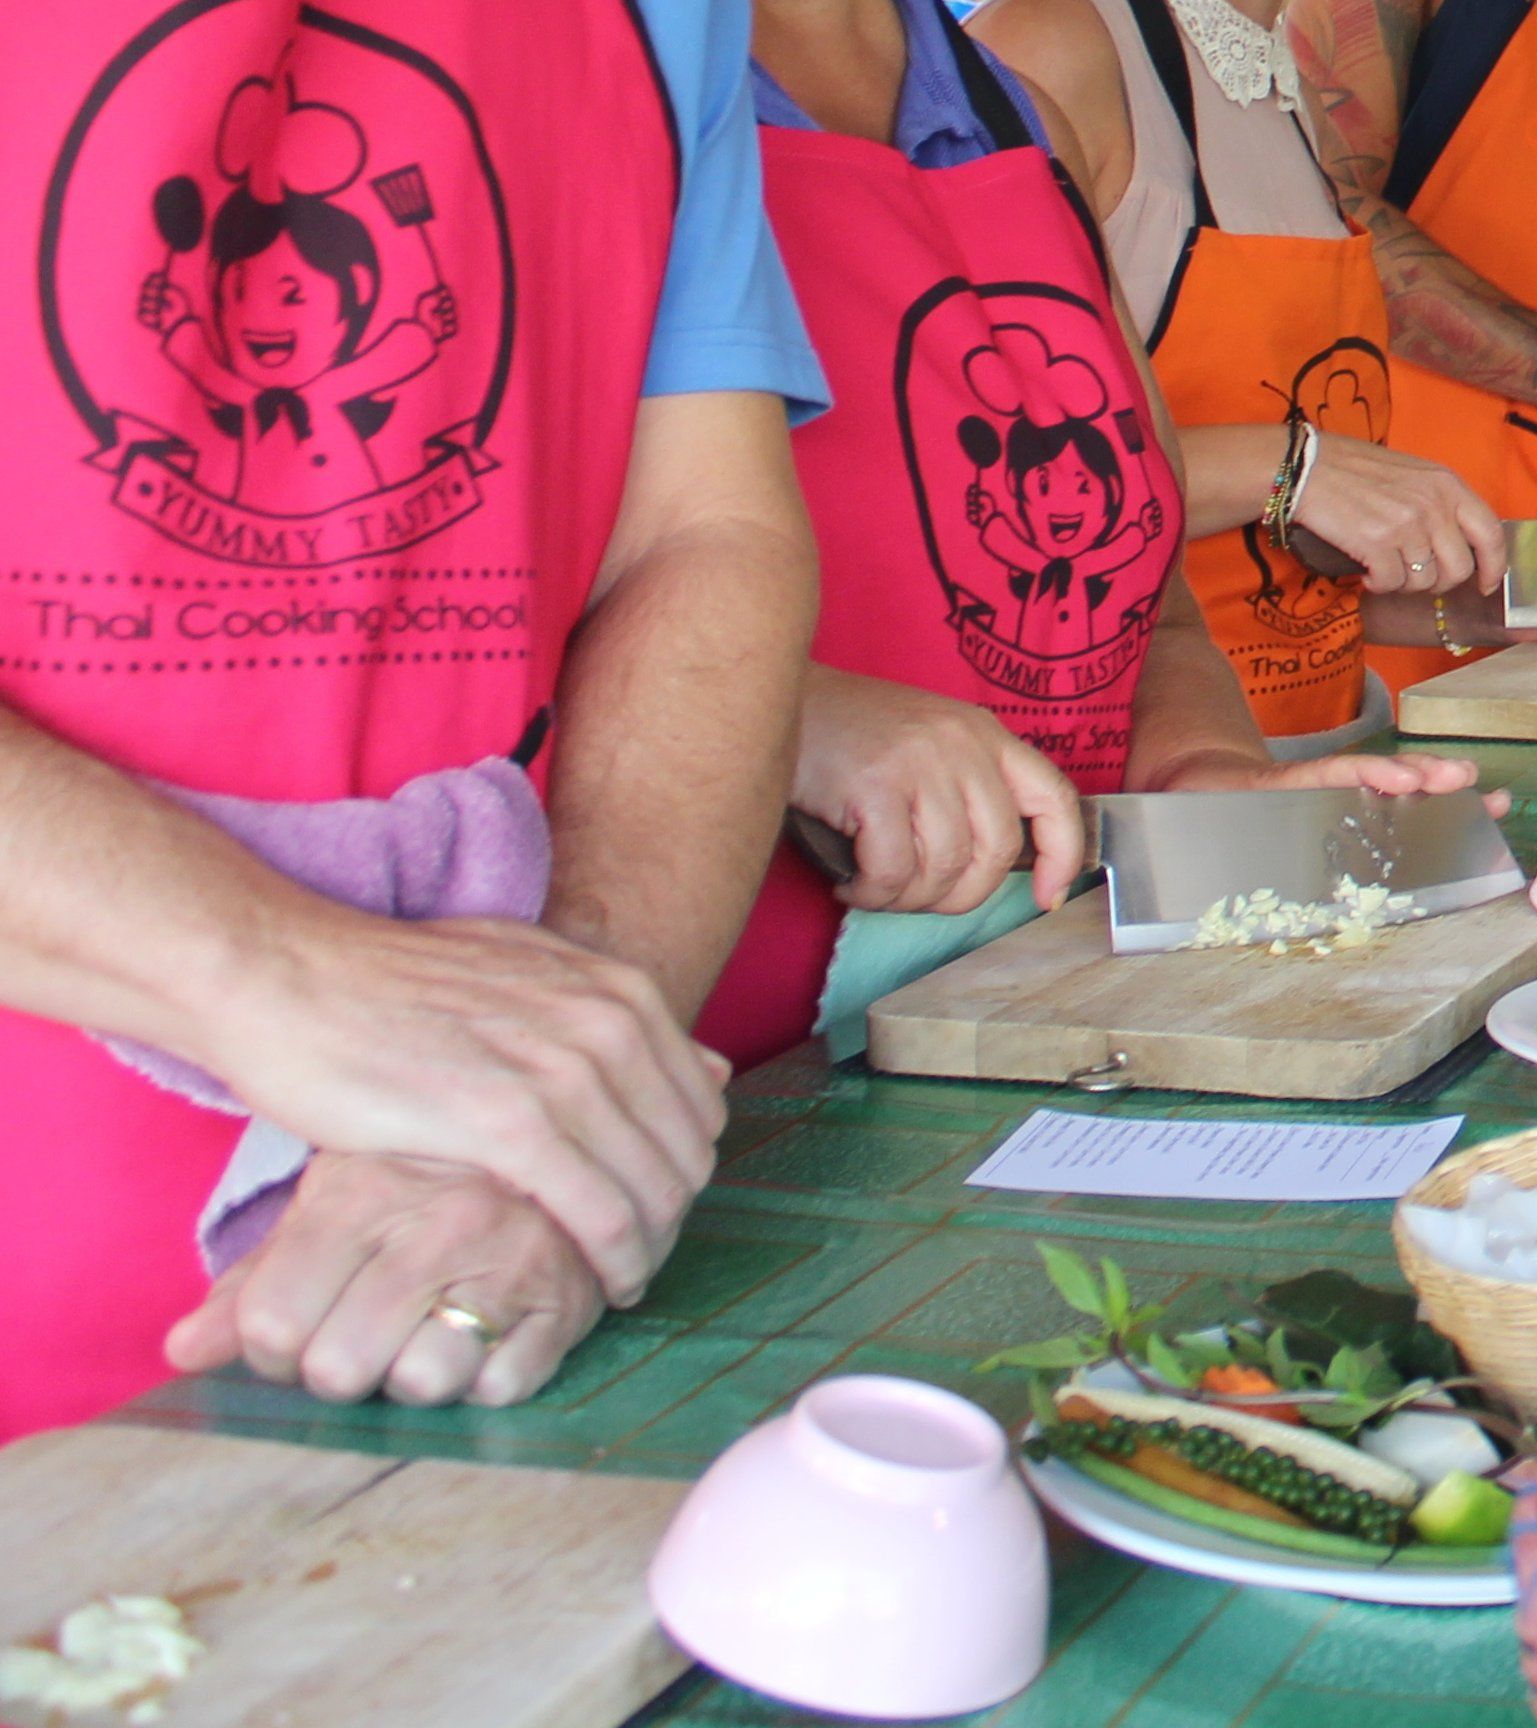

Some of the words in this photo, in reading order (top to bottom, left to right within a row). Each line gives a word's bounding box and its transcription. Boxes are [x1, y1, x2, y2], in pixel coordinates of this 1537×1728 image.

[160, 479, 322, 564] YUMMY
[348, 479, 451, 550] TASTY
[28, 600, 154, 641] Thai
[176, 599, 386, 643] Cooking
[390, 594, 526, 634] School
[973, 636, 1056, 694] YUMMY
[1069, 644, 1130, 693] TASTY
[1249, 649, 1300, 678] Thai
